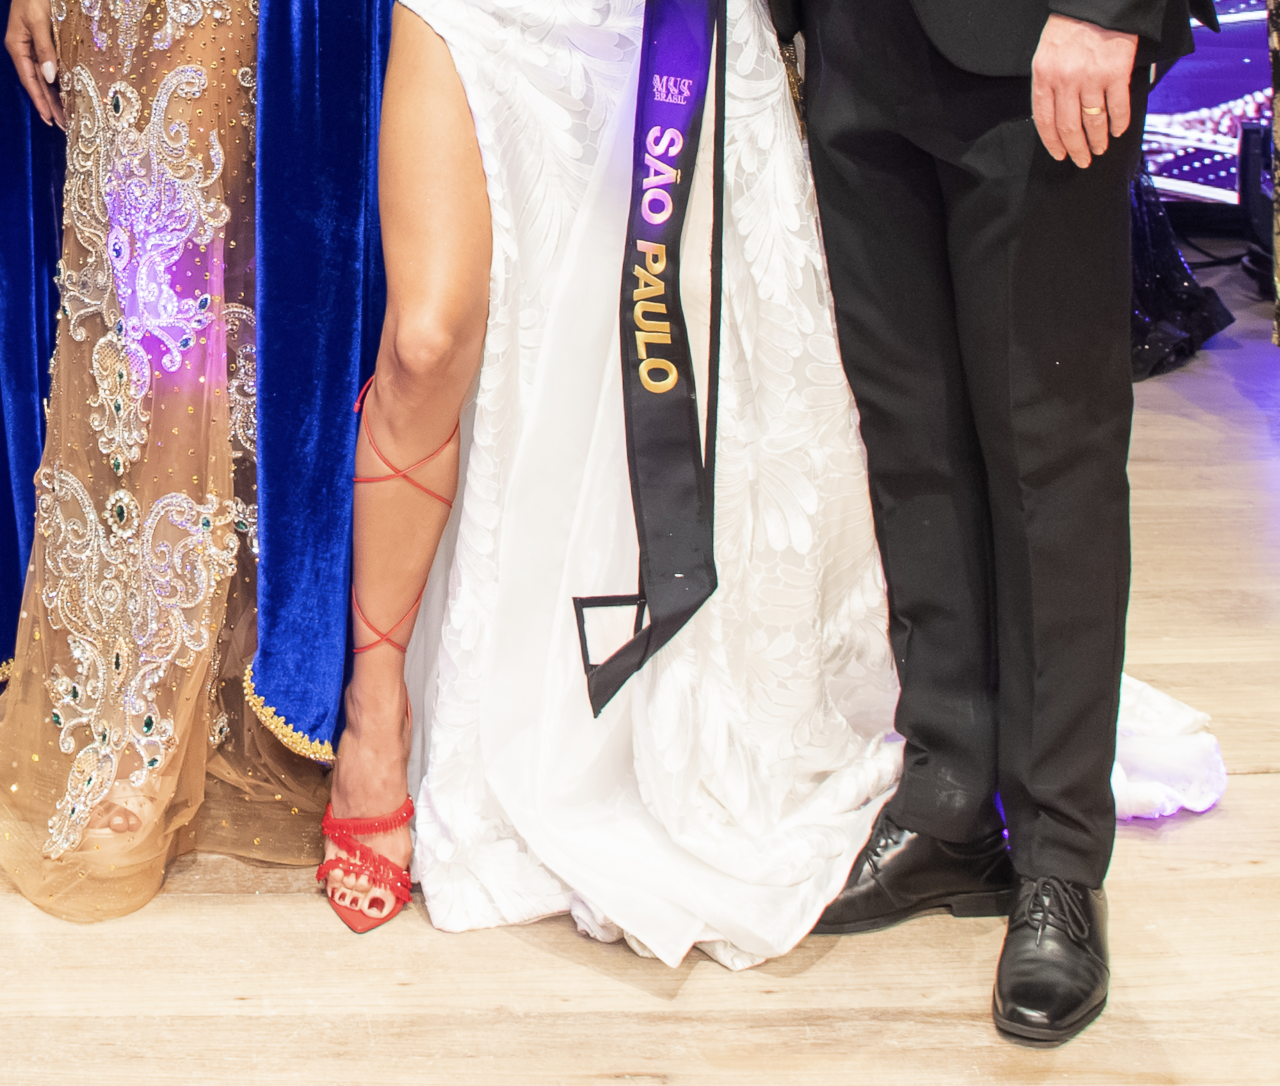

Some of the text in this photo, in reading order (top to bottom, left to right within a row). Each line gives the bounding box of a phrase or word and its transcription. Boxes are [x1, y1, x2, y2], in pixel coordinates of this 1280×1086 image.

[653, 91, 687, 105] BRASIL
[633, 125, 684, 394] SÃO PAULO
